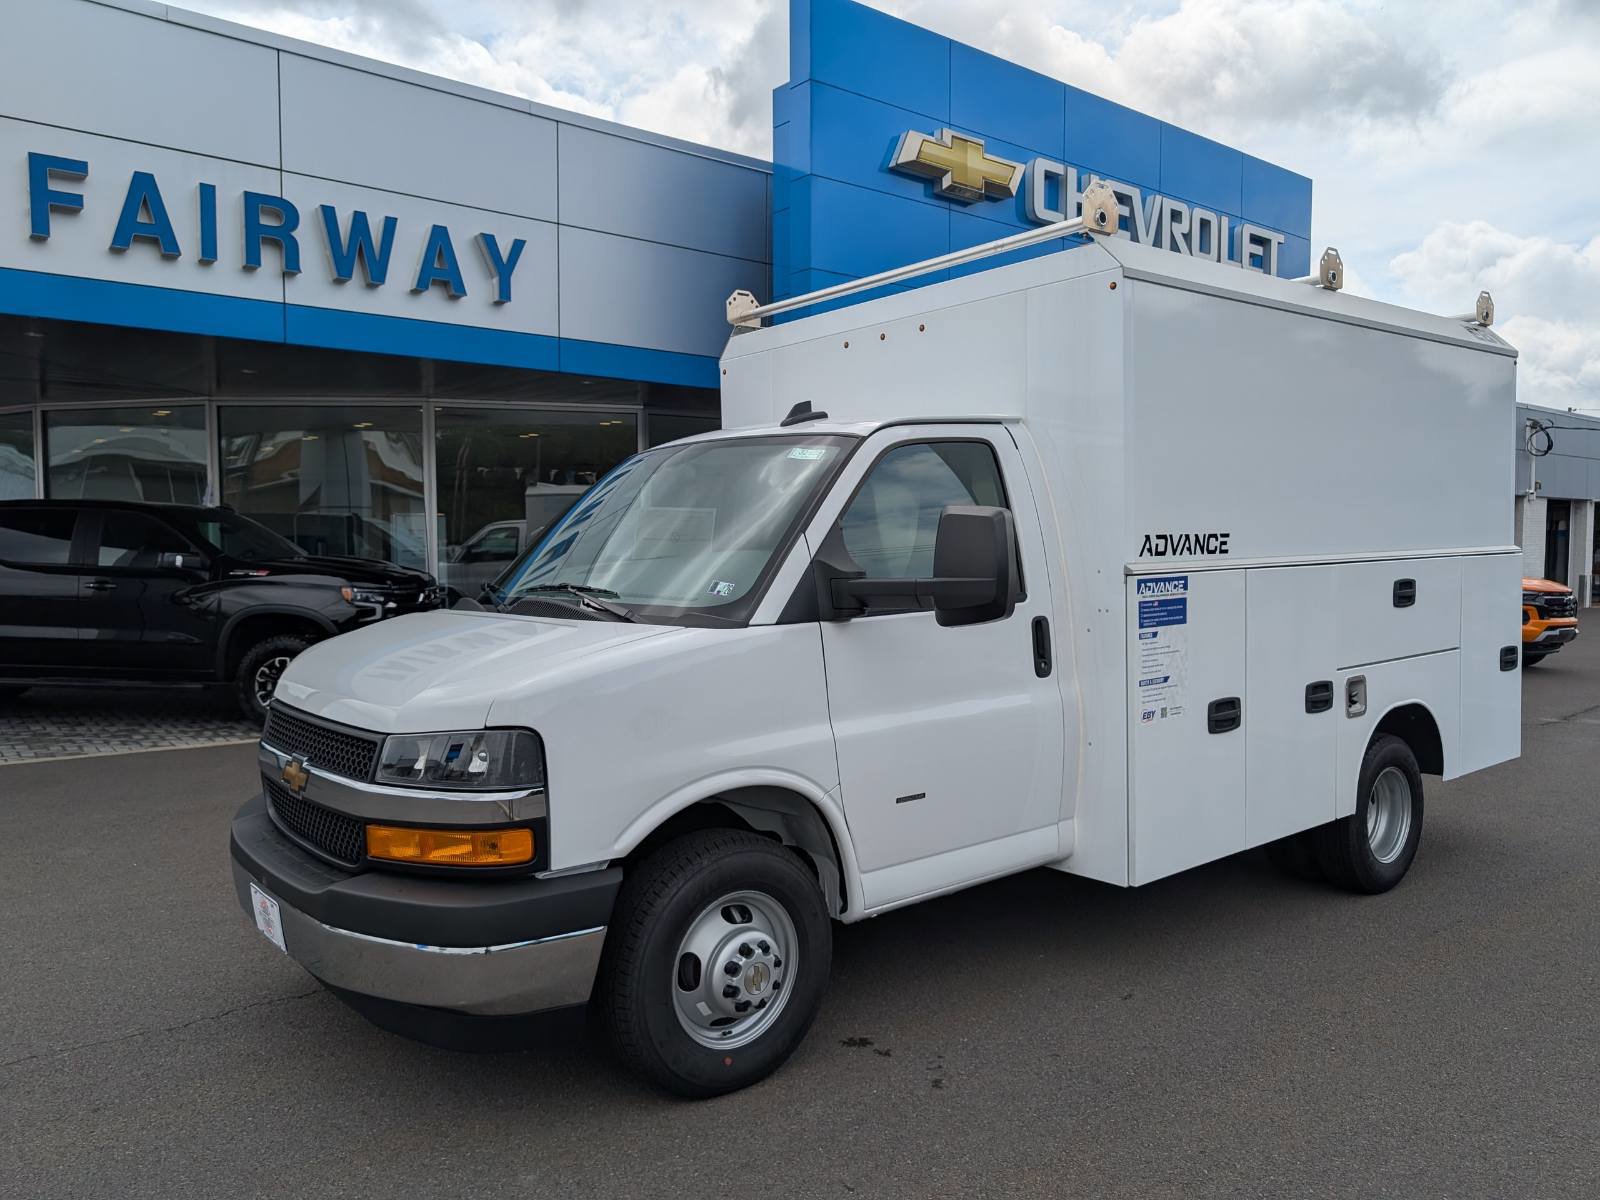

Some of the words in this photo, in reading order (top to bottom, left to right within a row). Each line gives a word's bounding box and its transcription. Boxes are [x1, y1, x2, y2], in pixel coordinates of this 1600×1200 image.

[28, 152, 527, 304] FAIRWAY
[1025, 157, 1286, 276] CHEVROLET
[1138, 533, 1230, 557] ADVANCE
[1138, 580, 1185, 595] ADVANCE
[1142, 709, 1156, 721] EBY
